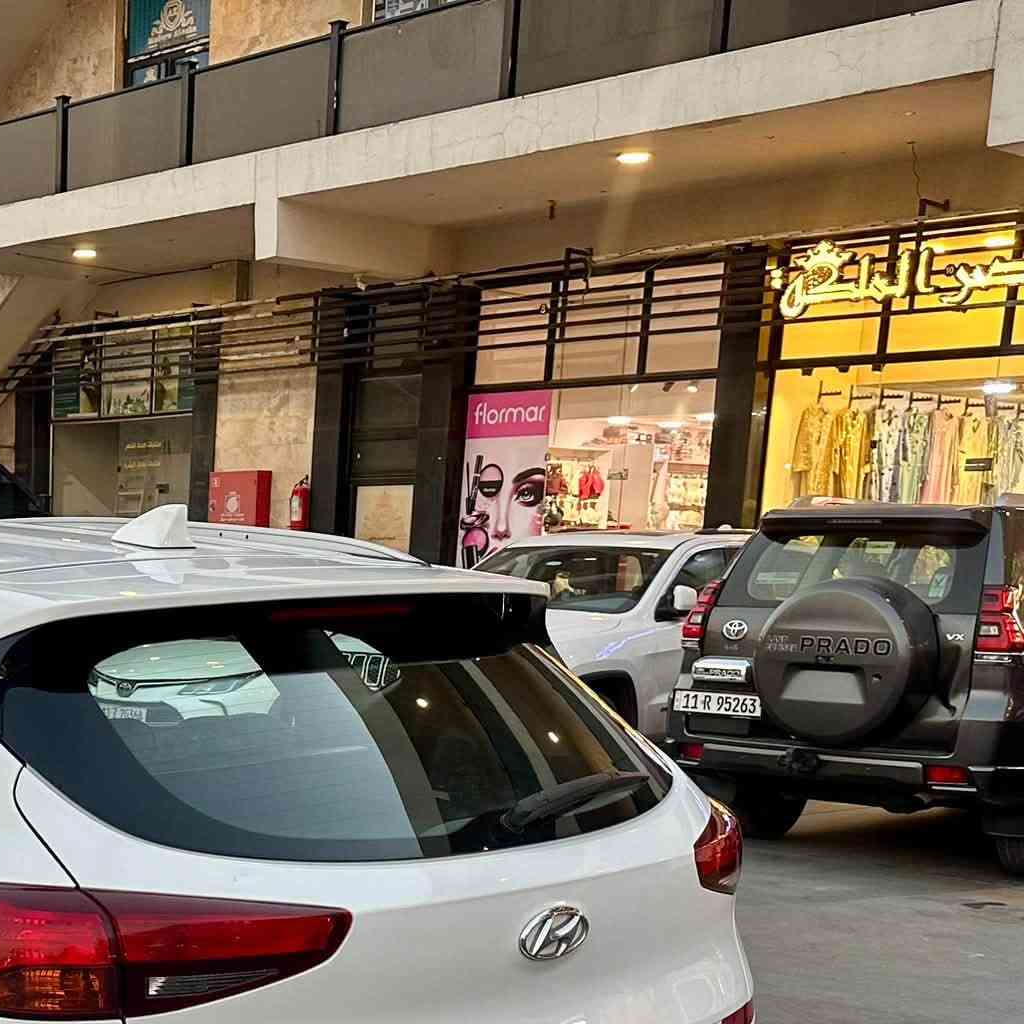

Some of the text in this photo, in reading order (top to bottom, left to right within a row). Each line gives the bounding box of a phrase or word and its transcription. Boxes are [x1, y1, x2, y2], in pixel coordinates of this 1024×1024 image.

[938, 256, 1024, 304] صر
[474, 402, 546, 424] flormar
[799, 635, 893, 656] PRADO
[946, 633, 967, 641] VX
[717, 696, 756, 713] 95263
